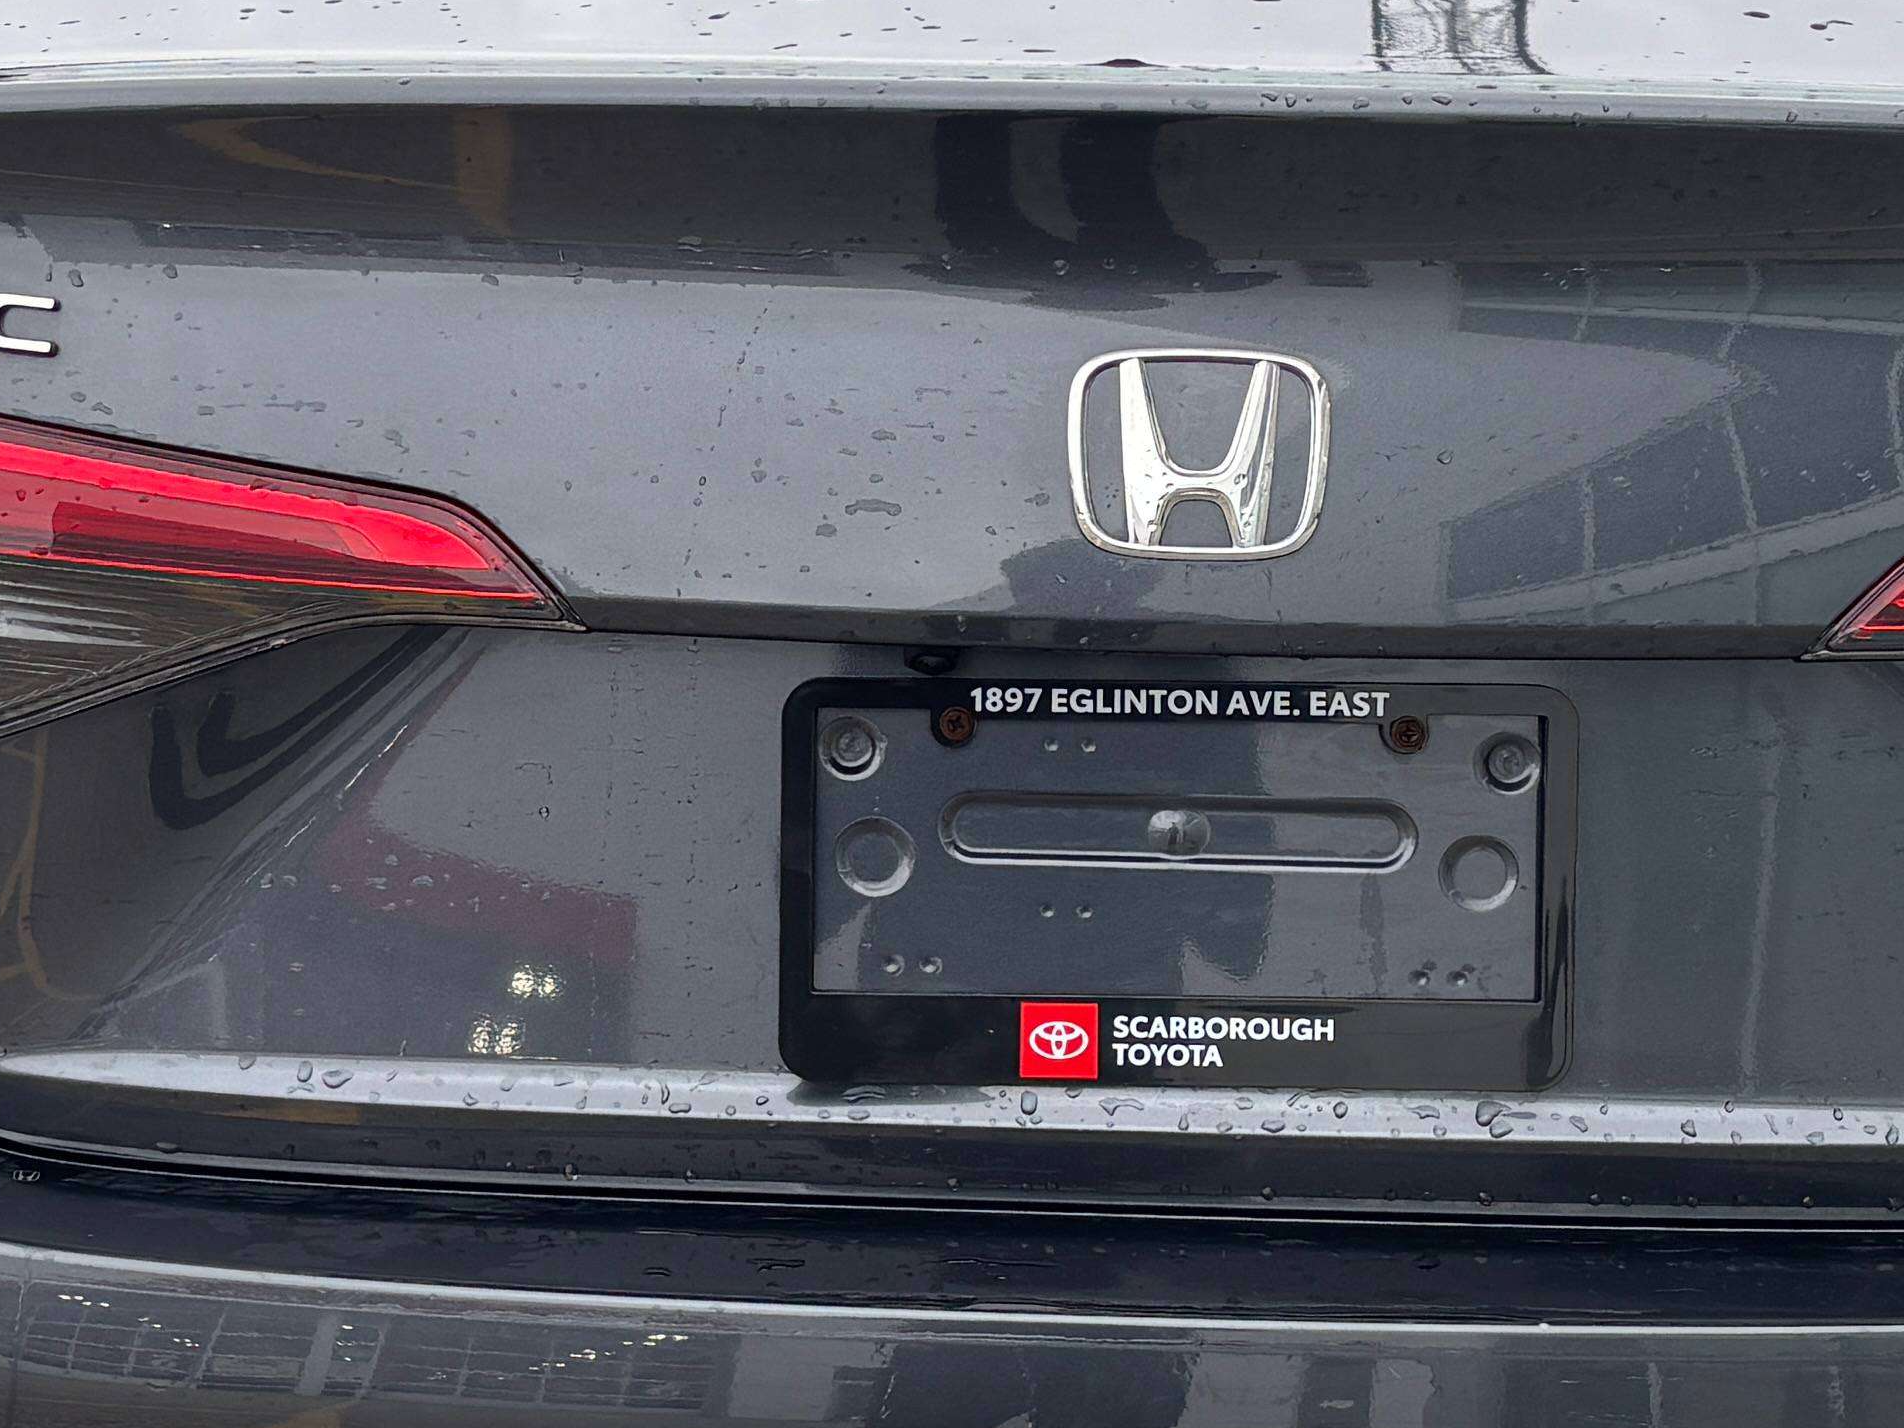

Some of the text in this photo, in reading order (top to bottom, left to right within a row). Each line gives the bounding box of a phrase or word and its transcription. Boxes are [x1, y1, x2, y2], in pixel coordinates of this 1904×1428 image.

[971, 687, 1390, 718] 1897 EGLINTON AVE. EAST
[1112, 1015, 1335, 1041] SCARBOROUGH
[1112, 1043, 1224, 1068] TOYOTA
